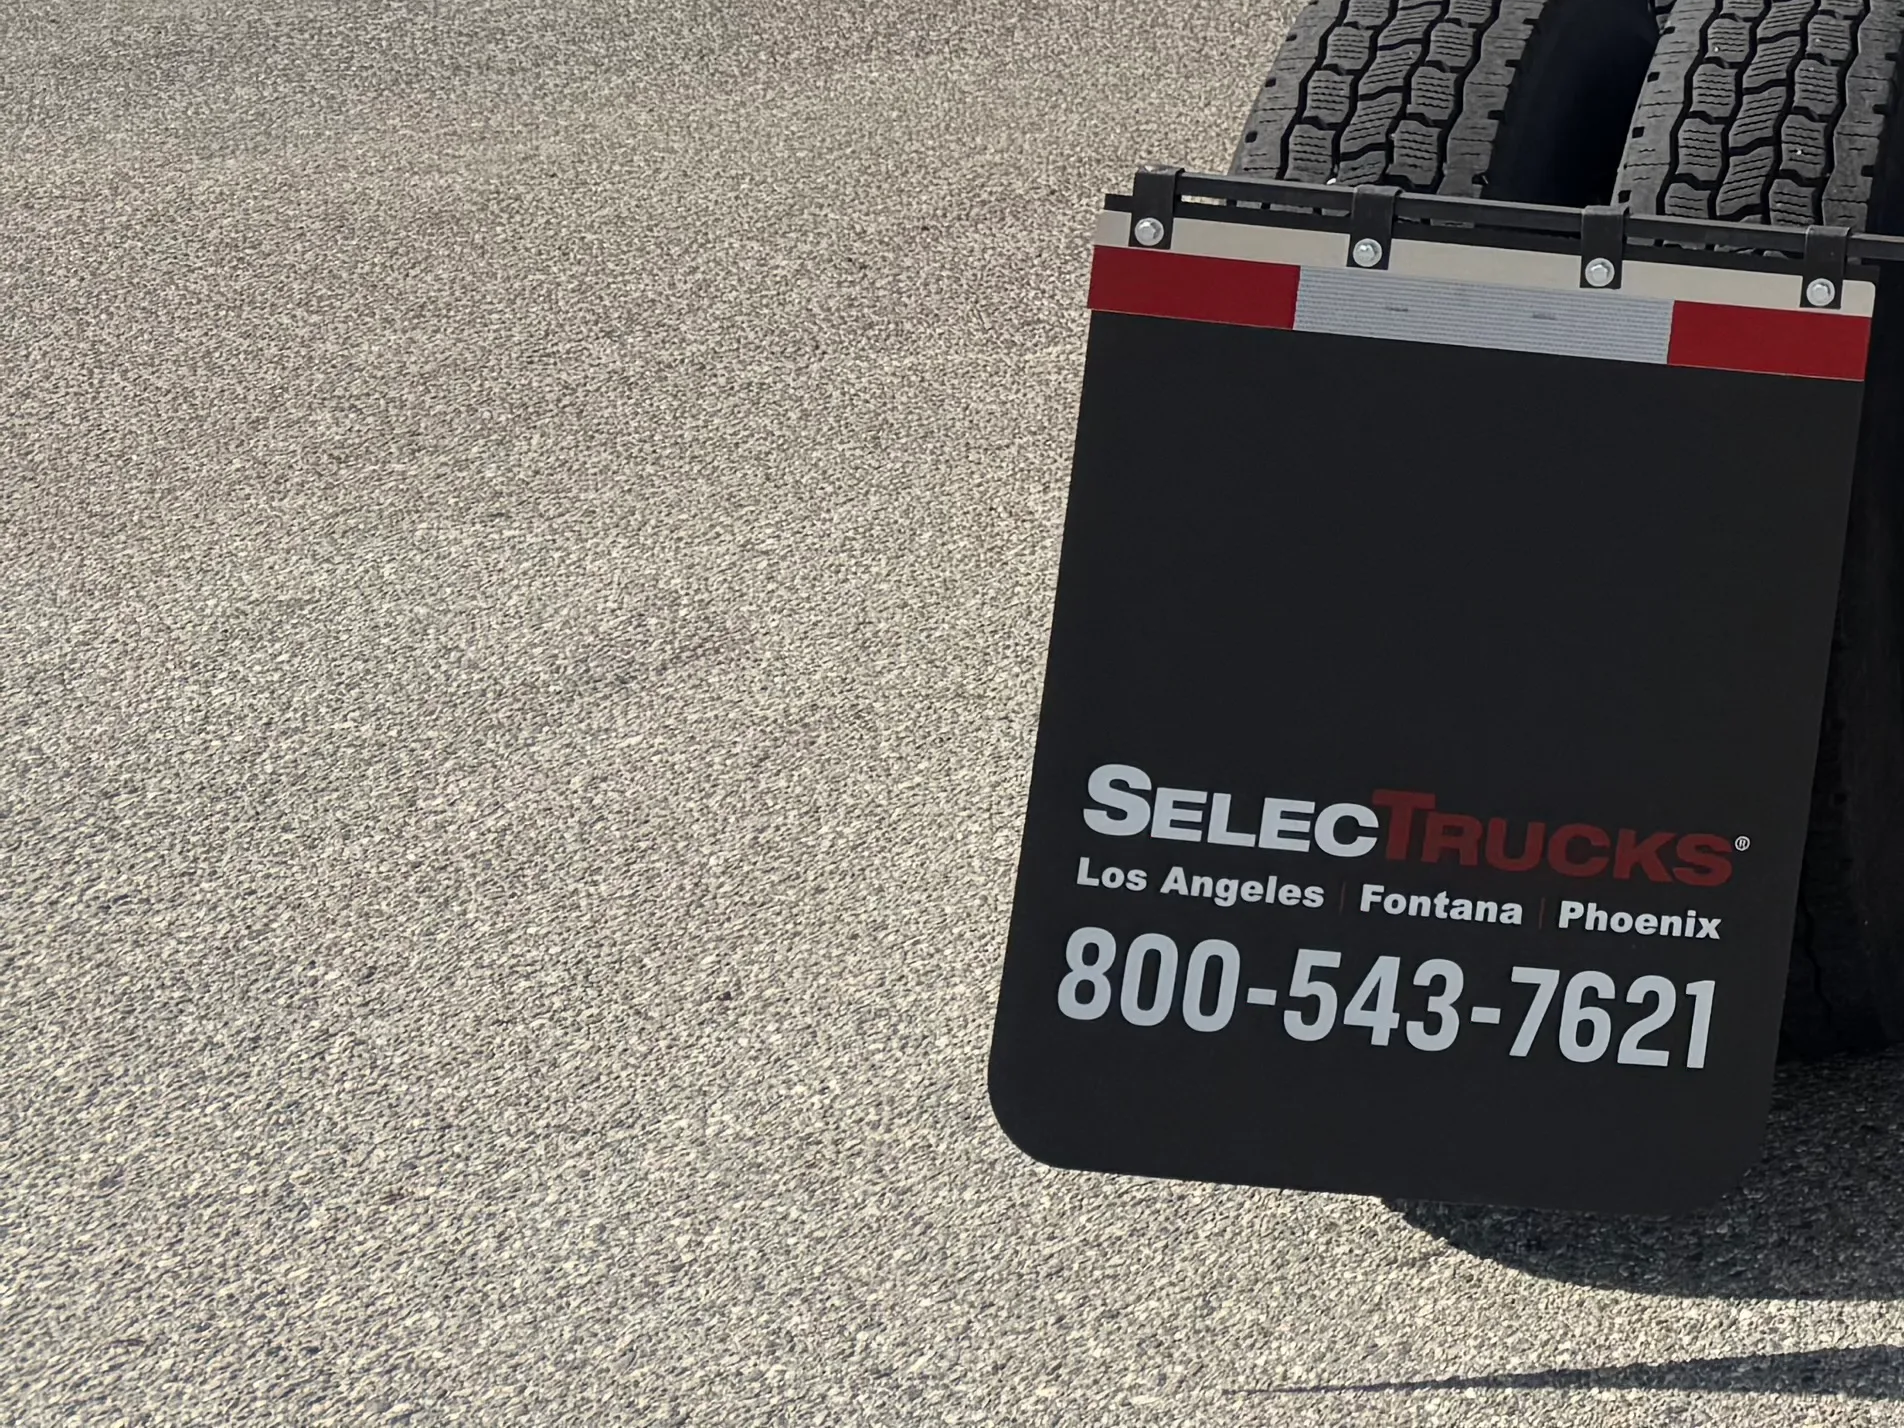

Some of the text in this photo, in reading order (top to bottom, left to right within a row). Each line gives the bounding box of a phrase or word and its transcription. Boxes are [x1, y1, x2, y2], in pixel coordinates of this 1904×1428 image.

[1077, 857, 1721, 940] Los Angeles Fontana Phoenix
[1058, 927, 1715, 1068] 800-543-7621
